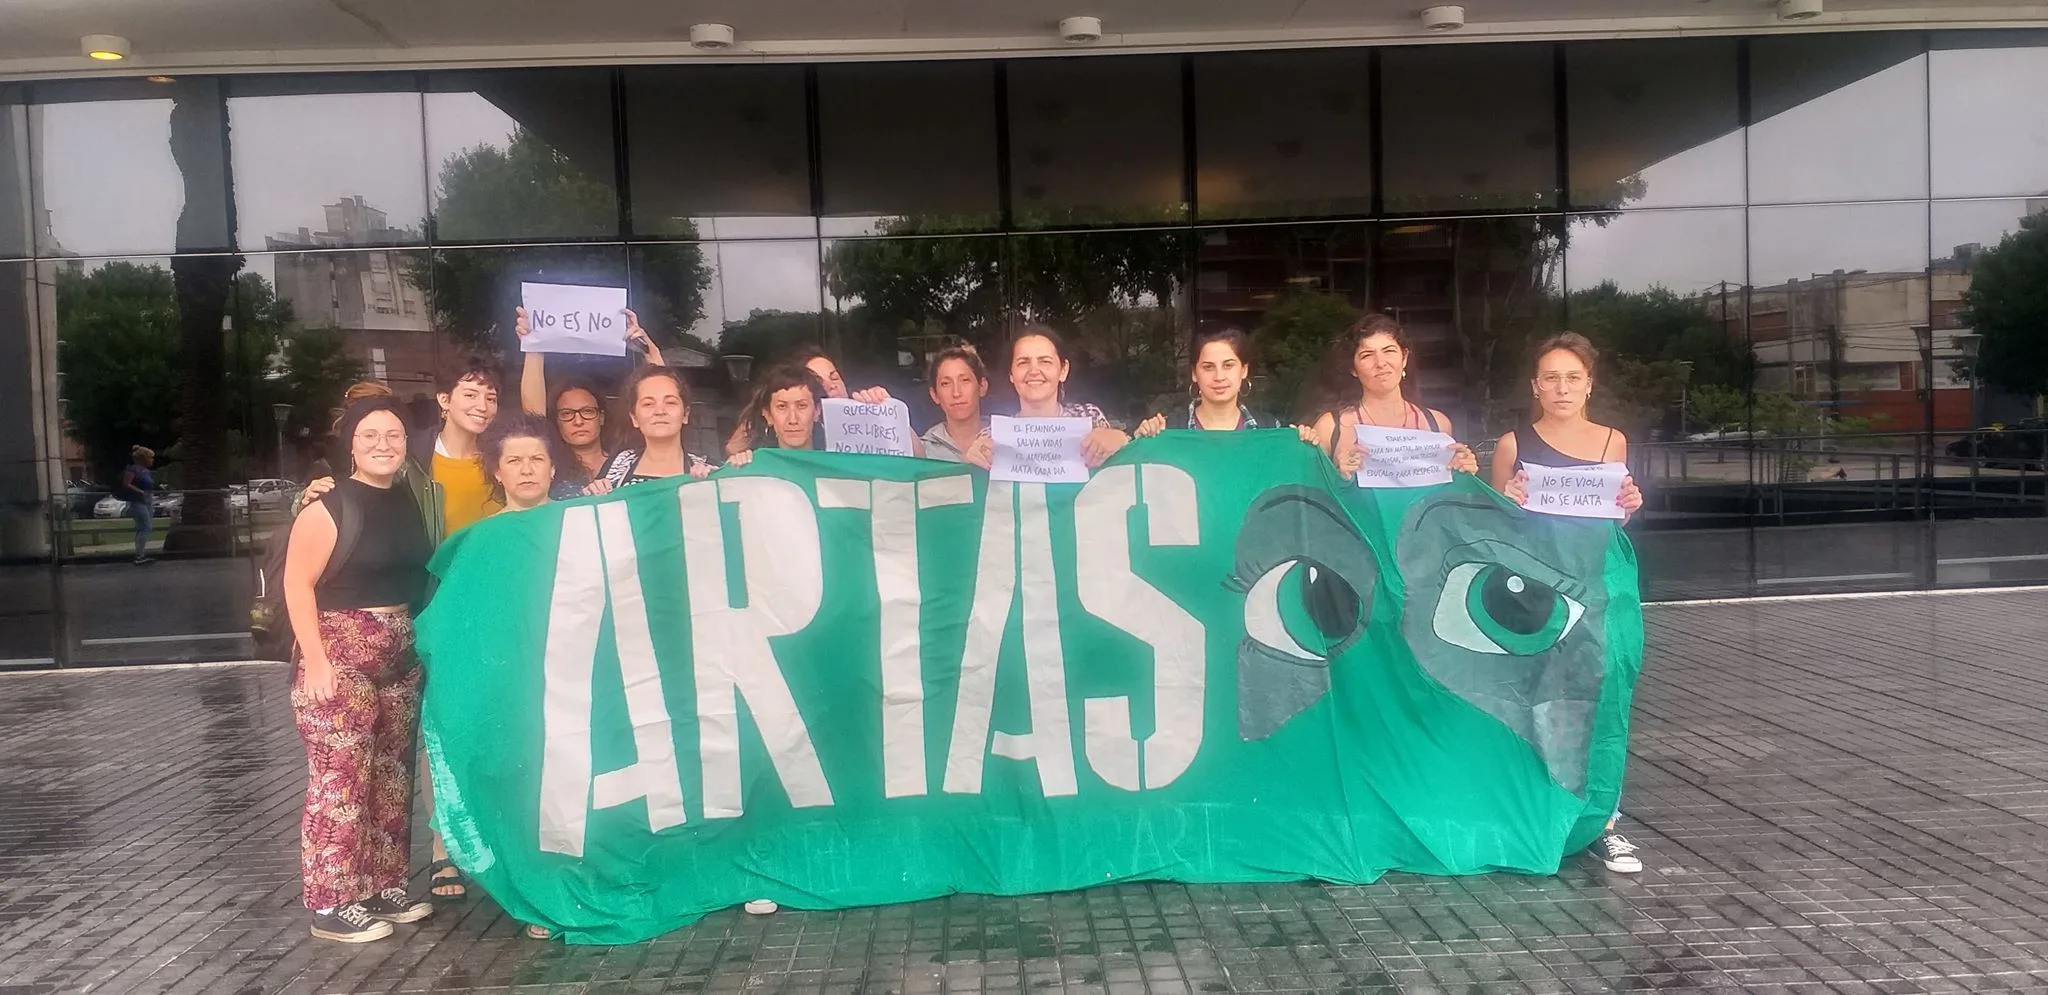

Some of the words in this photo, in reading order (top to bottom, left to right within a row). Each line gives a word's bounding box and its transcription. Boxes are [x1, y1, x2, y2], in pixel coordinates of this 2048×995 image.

[532, 310, 556, 330] NO
[563, 311, 580, 332] ES
[589, 313, 612, 332] NO
[843, 405, 898, 419] QUEREMOS
[842, 423, 863, 435] SER
[866, 424, 899, 443] LIBRES,
[1025, 424, 1066, 433] FEMINISMO
[836, 442, 851, 453] NO
[1017, 438, 1040, 447] SALVA
[1042, 438, 1063, 447] VIDAS
[1010, 465, 1032, 474] MATA
[1034, 467, 1051, 476] CADA
[1054, 466, 1066, 476] DIA
[1542, 476, 1556, 488] NO
[1560, 476, 1572, 488] SE
[1576, 477, 1604, 488] VIOLA
[1540, 494, 1555, 506] NO
[1559, 494, 1570, 506] SE
[1573, 494, 1602, 506] MATA
[539, 464, 1206, 857] ARTAS
